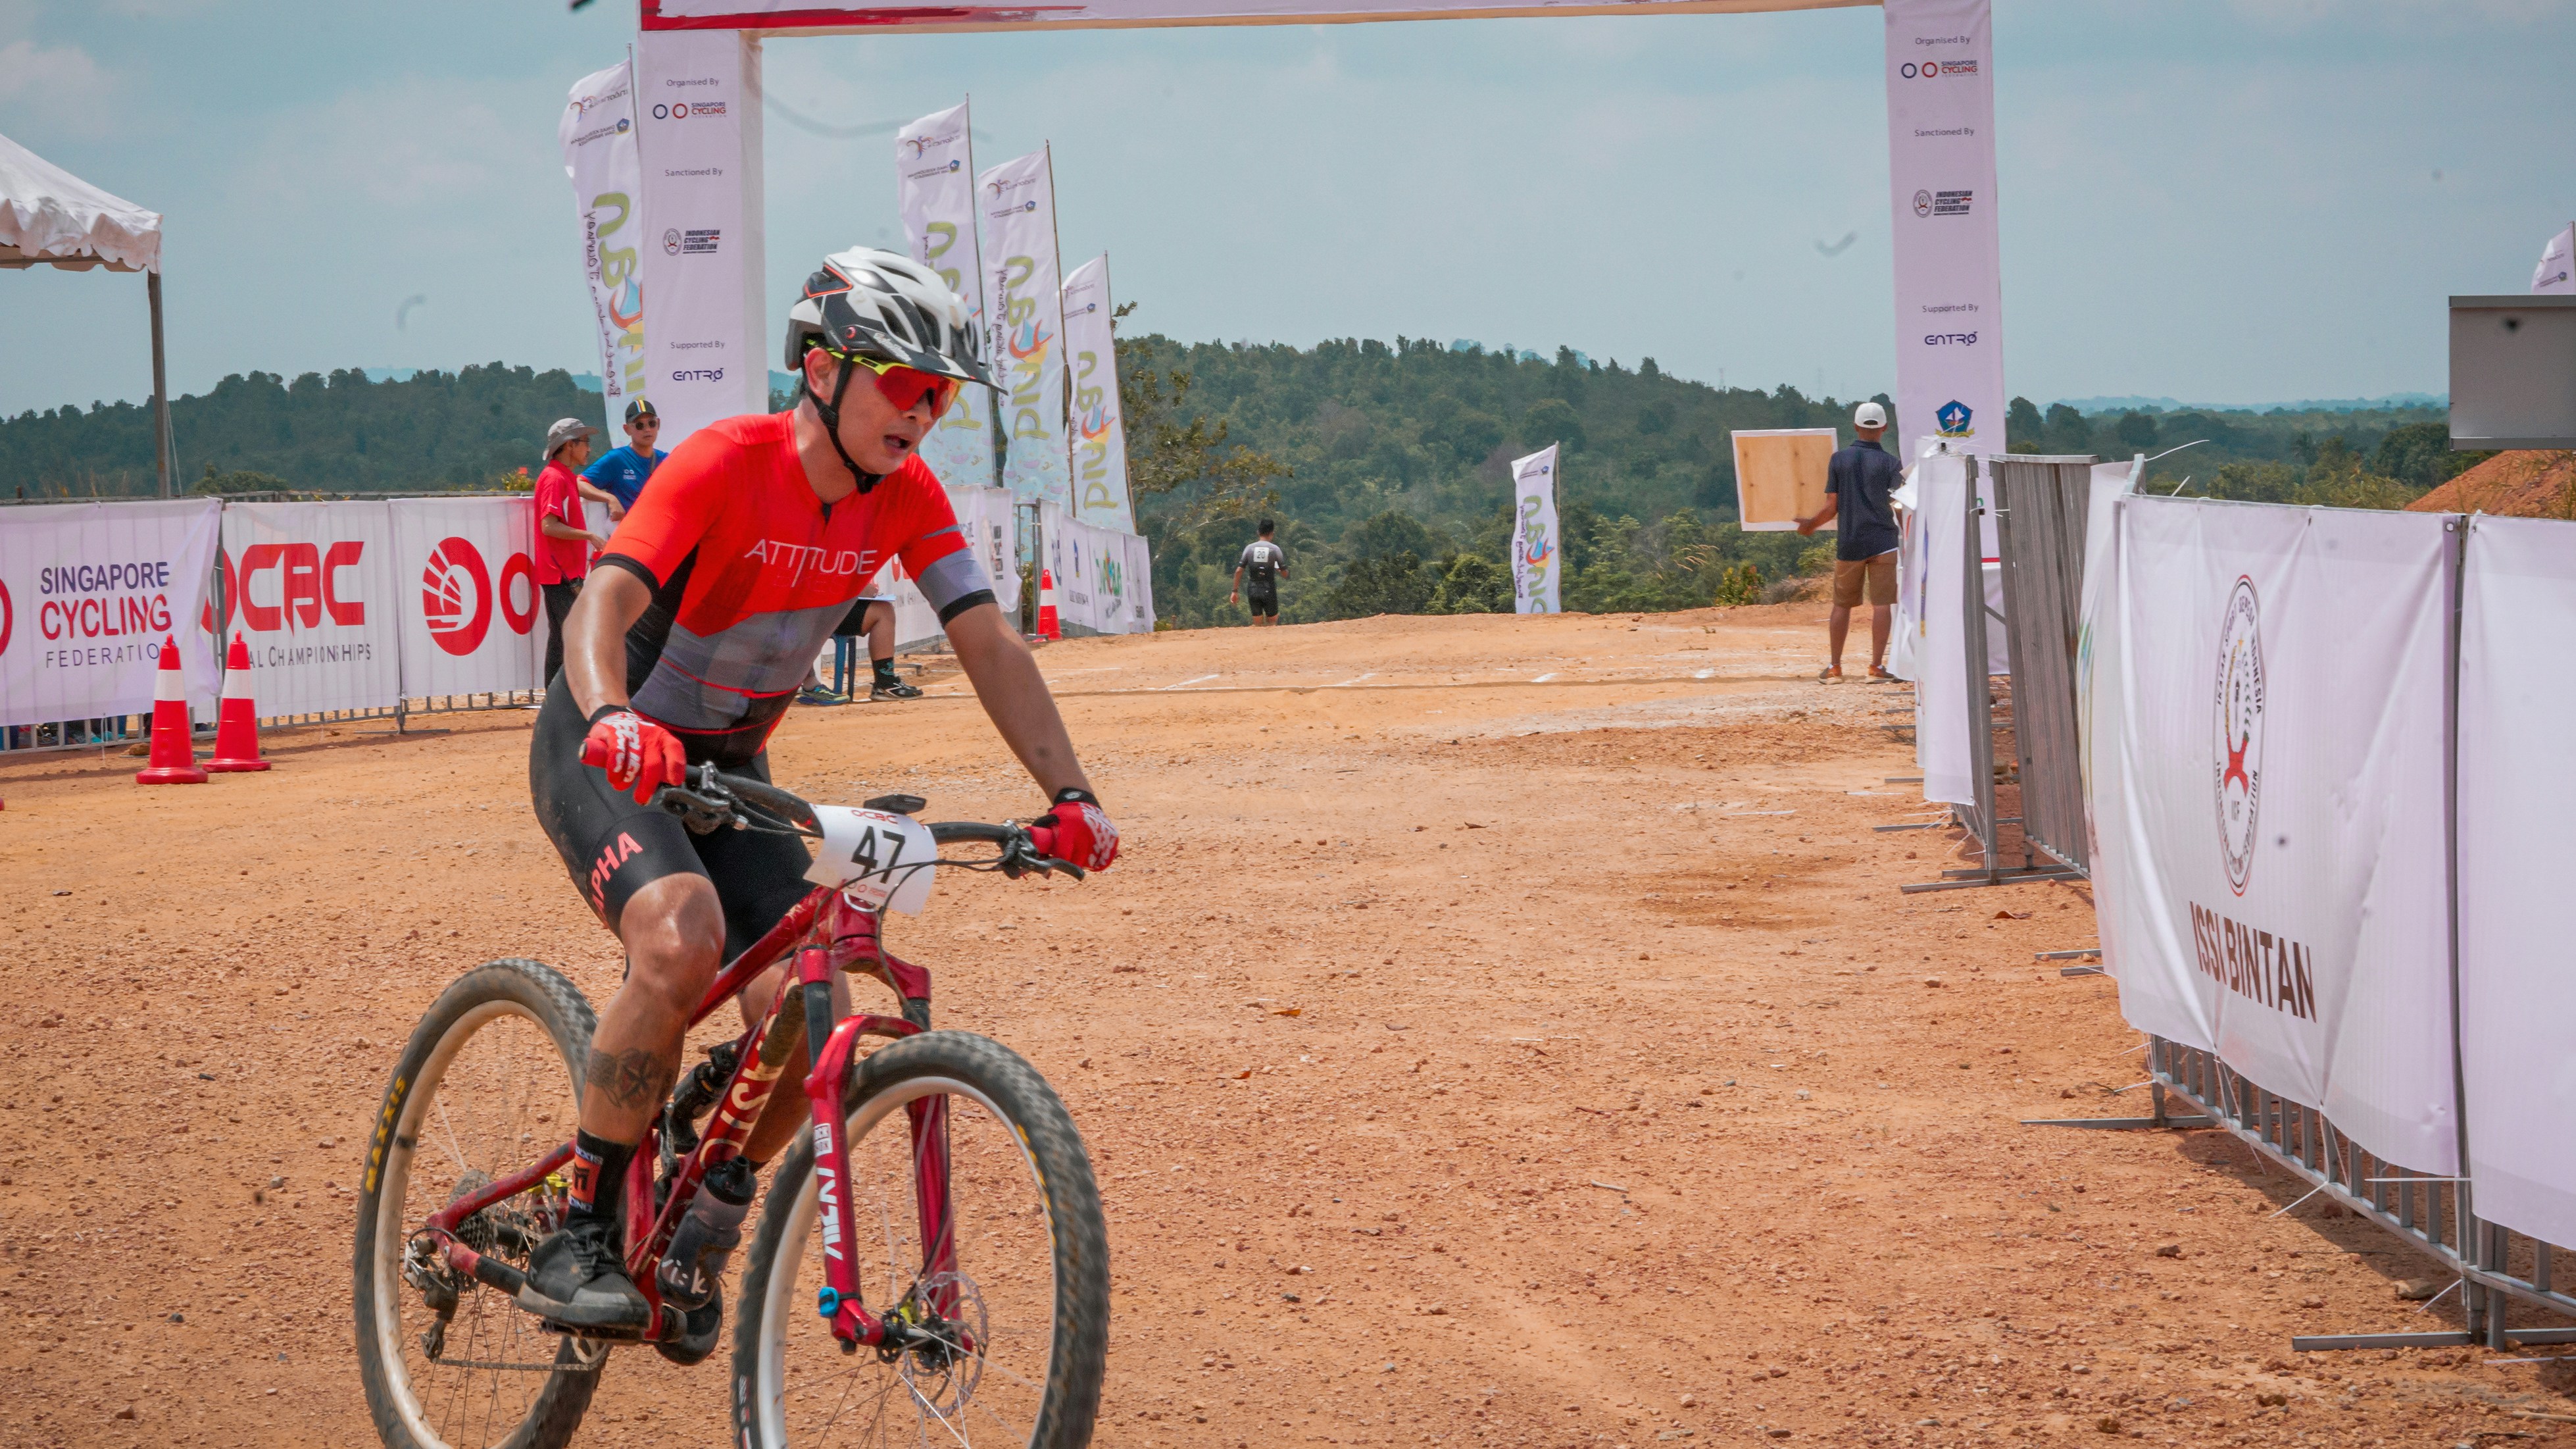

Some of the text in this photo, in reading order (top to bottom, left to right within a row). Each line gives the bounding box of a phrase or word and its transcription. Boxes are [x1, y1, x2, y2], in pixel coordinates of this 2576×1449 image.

[1915, 36, 1970, 46] Organised By
[666, 78, 720, 88] Organised By
[1915, 128, 1975, 137] Sanctioned By
[665, 168, 710, 176] Sanctioned
[1922, 303, 1979, 313] Supported By
[670, 340, 725, 350] Supported By
[744, 539, 878, 588] ATTITUDE
[40, 561, 170, 594] SINGAPORE
[40, 594, 172, 640] CYCLING
[46, 641, 176, 668] FEDERATIO
[851, 809, 898, 825] OCBC
[851, 825, 906, 884] 47
[2189, 901, 2317, 1023] ISSI BINTAN
